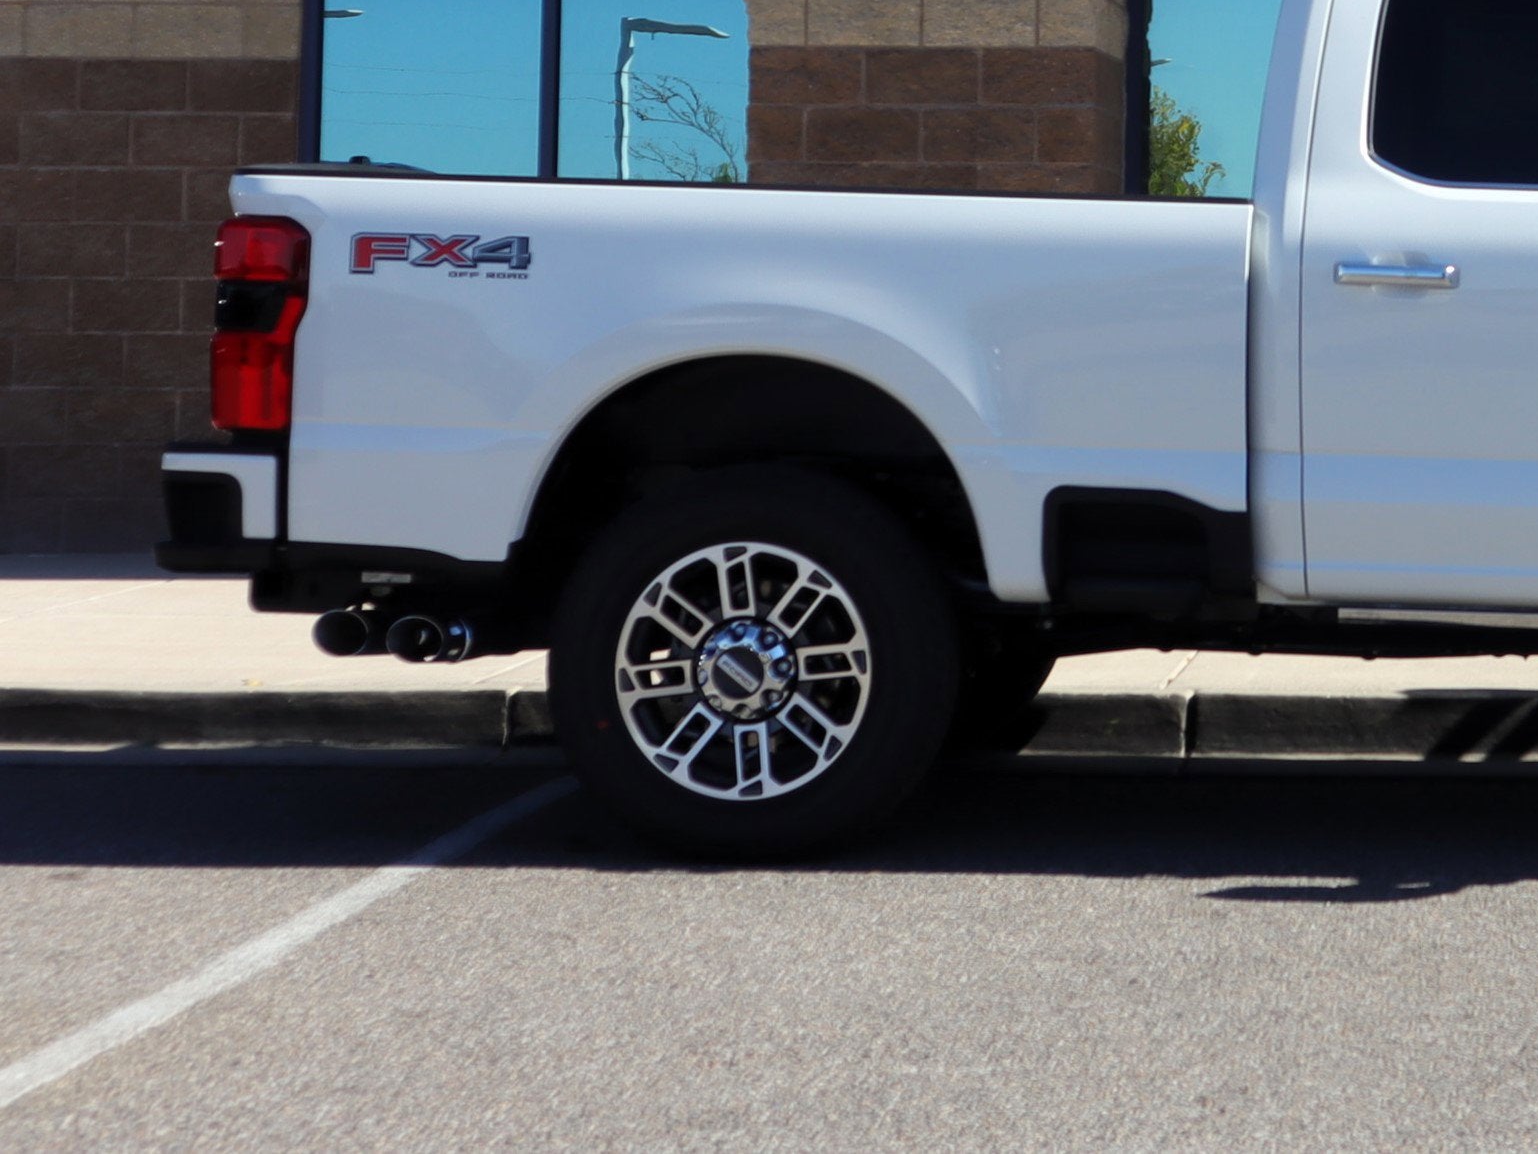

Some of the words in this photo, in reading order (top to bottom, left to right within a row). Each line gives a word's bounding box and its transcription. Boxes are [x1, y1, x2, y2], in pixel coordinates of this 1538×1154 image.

[350, 232, 531, 274] FX4
[486, 272, 529, 280] ROAD
[722, 660, 753, 687] FORD
